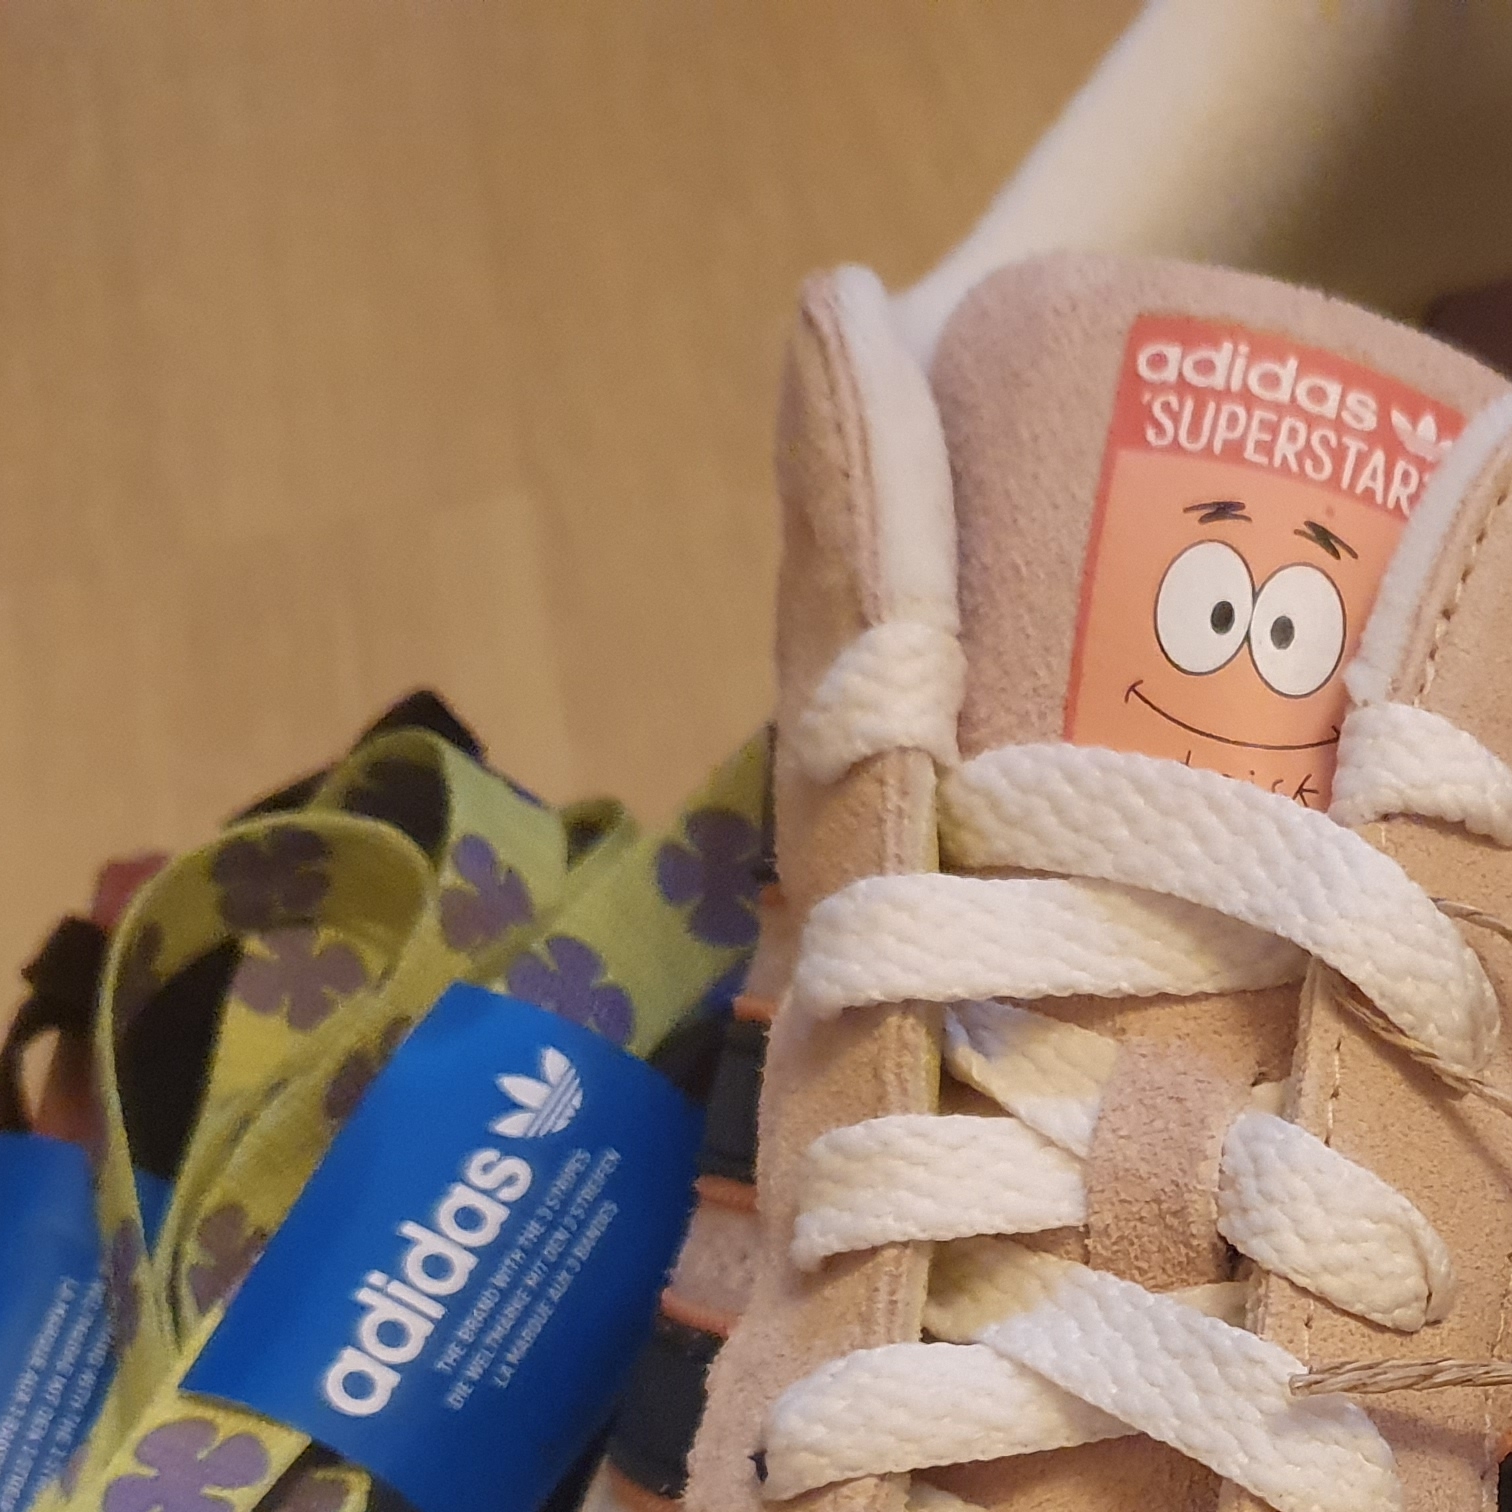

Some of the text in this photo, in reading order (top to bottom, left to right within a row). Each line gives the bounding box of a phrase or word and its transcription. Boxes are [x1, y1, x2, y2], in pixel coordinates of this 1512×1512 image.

[1137, 342, 1378, 432] adidas
[325, 1148, 533, 1416] adidas
[436, 1340, 467, 1375] THE
